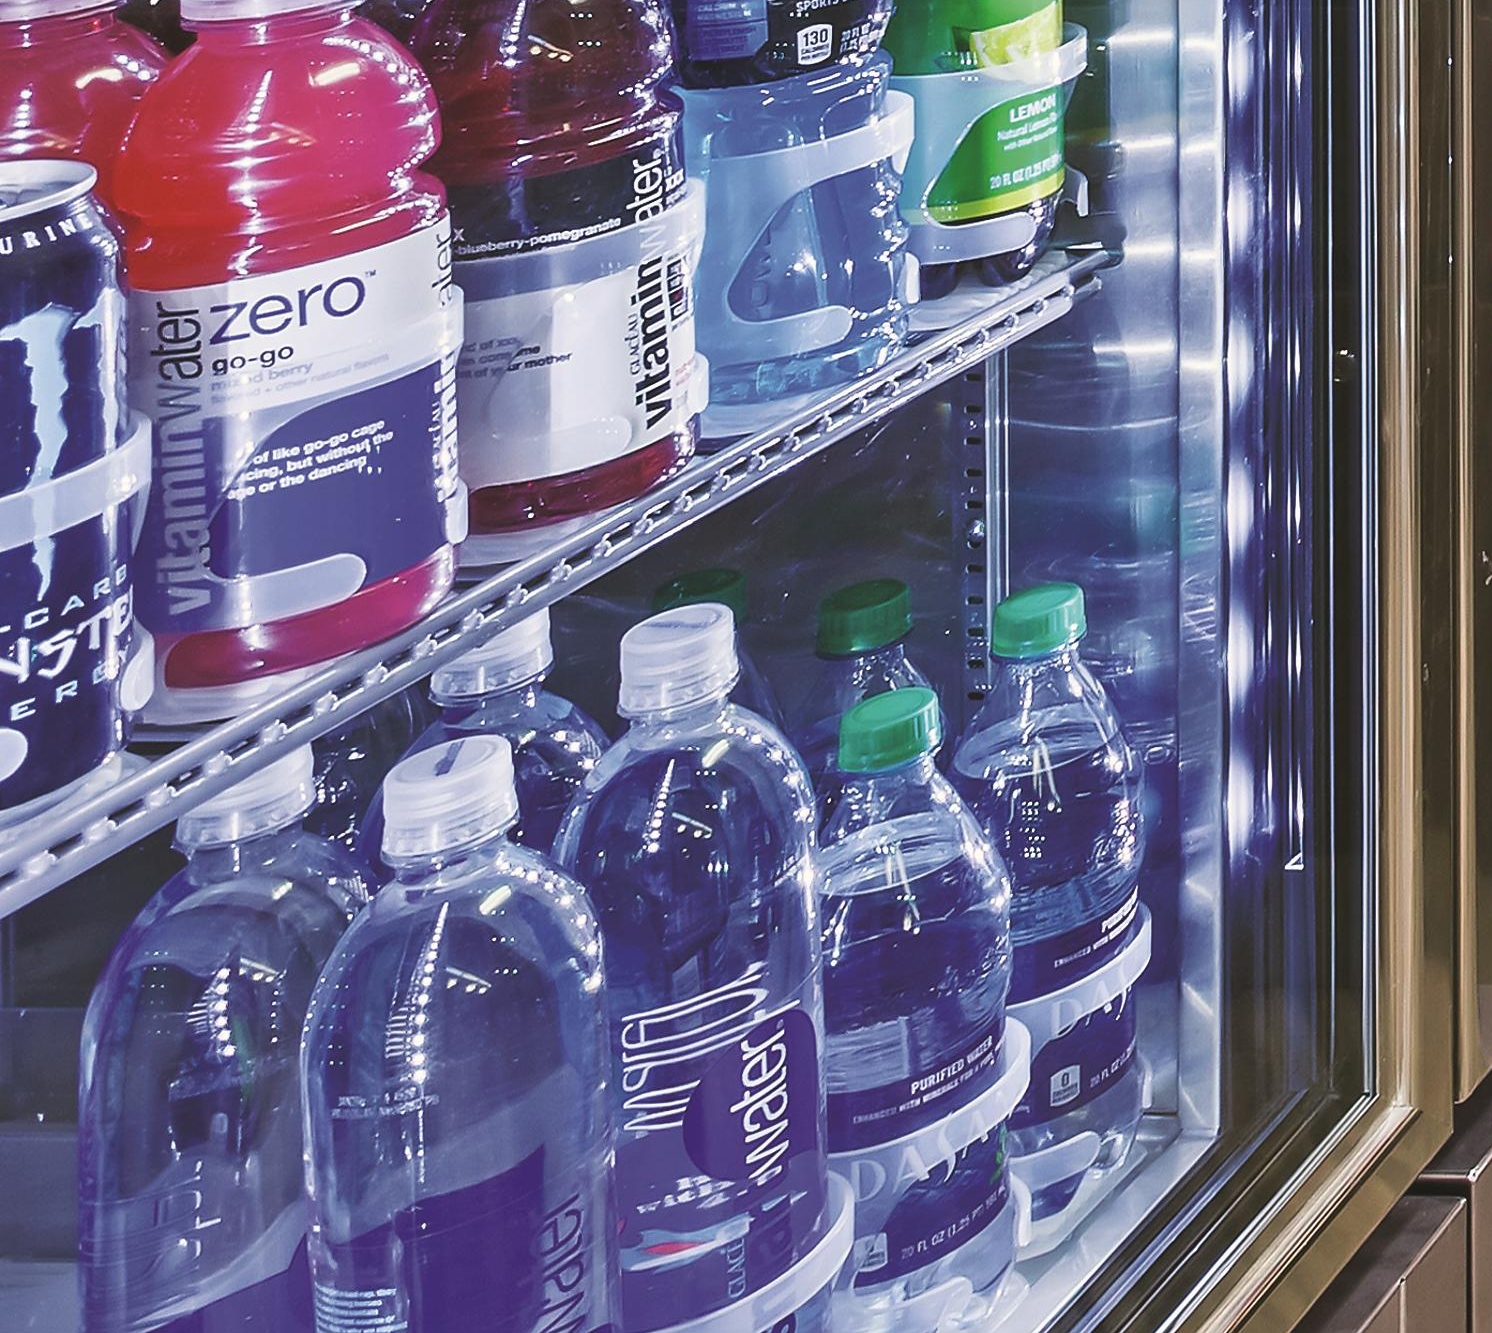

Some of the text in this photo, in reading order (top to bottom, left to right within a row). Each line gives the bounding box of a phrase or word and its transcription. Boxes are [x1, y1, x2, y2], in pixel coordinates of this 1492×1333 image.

[803, 29, 829, 47] 130
[1009, 94, 1056, 122] LEMON
[209, 275, 366, 345] zero
[211, 345, 294, 375] go-go
[525, 352, 573, 369] mother
[273, 447, 300, 460] like
[304, 434, 349, 453] go-go
[351, 420, 385, 438] cage
[287, 431, 394, 471] but without the
[259, 455, 367, 493] or the dancing
